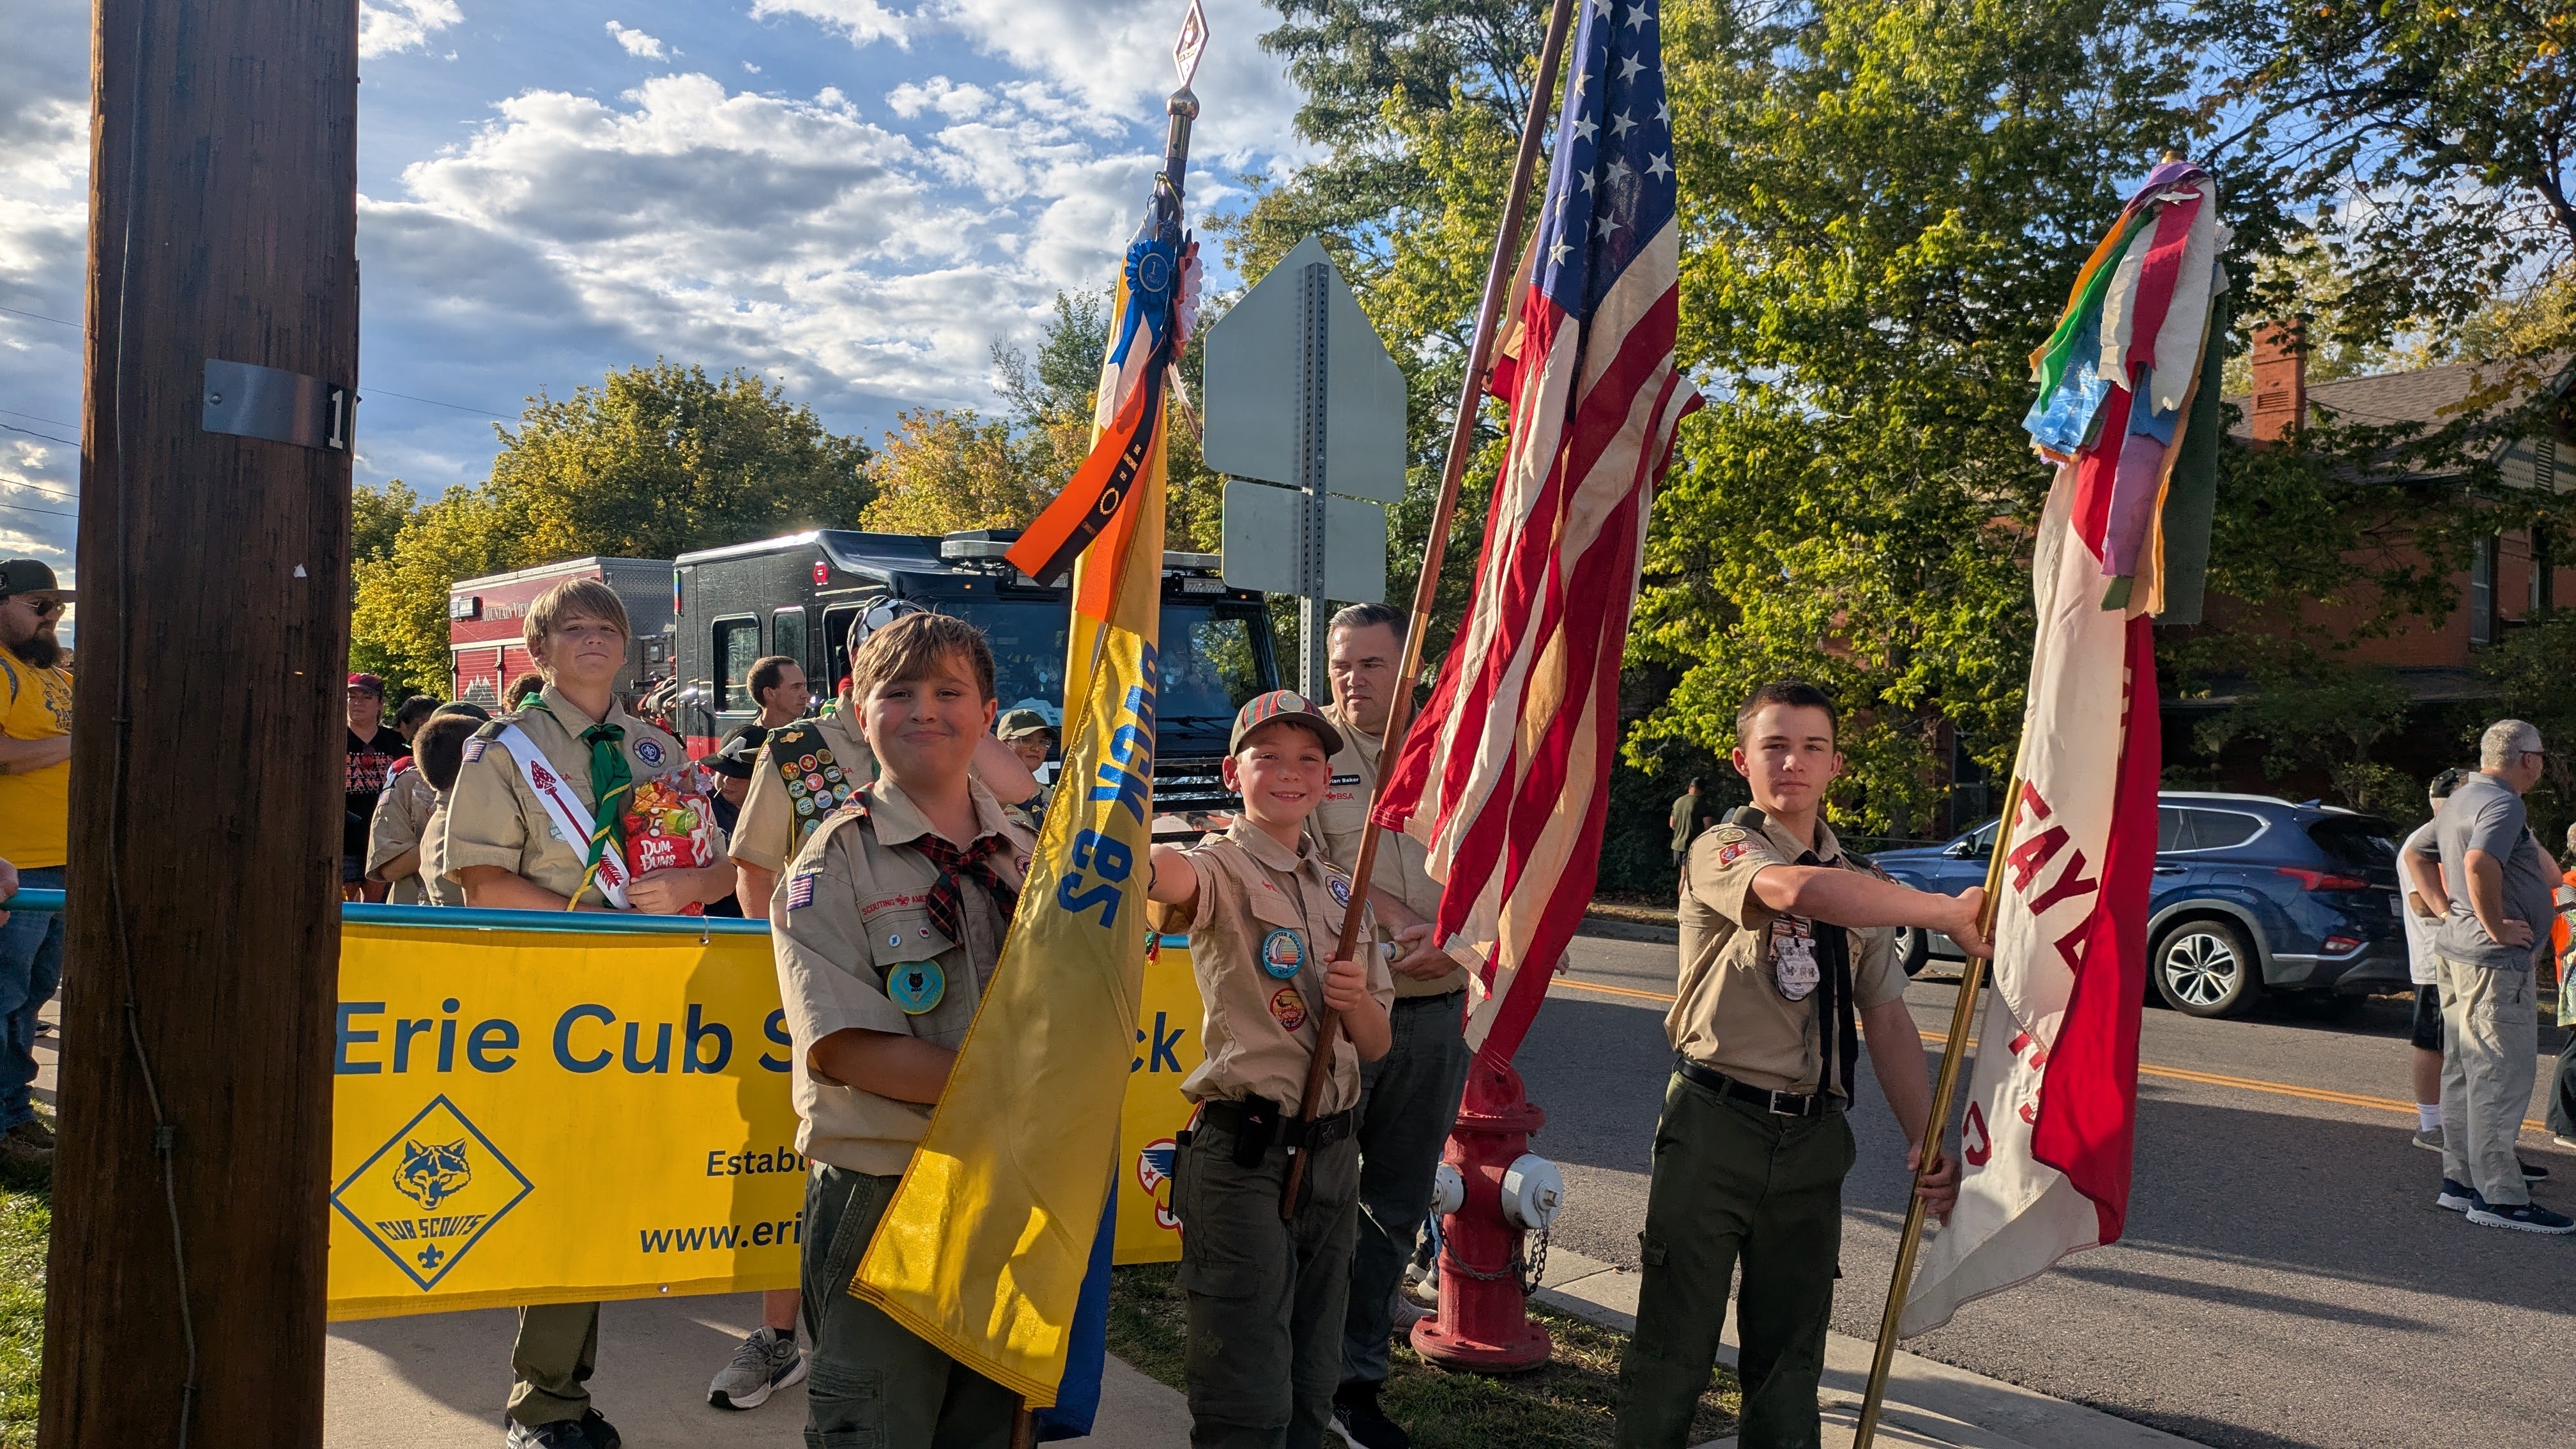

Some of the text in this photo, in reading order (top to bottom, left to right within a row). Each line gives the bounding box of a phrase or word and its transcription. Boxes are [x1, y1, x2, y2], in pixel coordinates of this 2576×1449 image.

[480, 603, 513, 622] MOUNTAIN
[1336, 792, 1354, 801] BSA
[640, 854, 677, 872] DUMS
[861, 898, 896, 916] SCOUTING
[1265, 931, 1302, 959] RAINGUTTER REGATTA
[334, 997, 520, 1075] Erie
[552, 1003, 733, 1075] Cub
[374, 1214, 488, 1241] CUB SCOUTS
